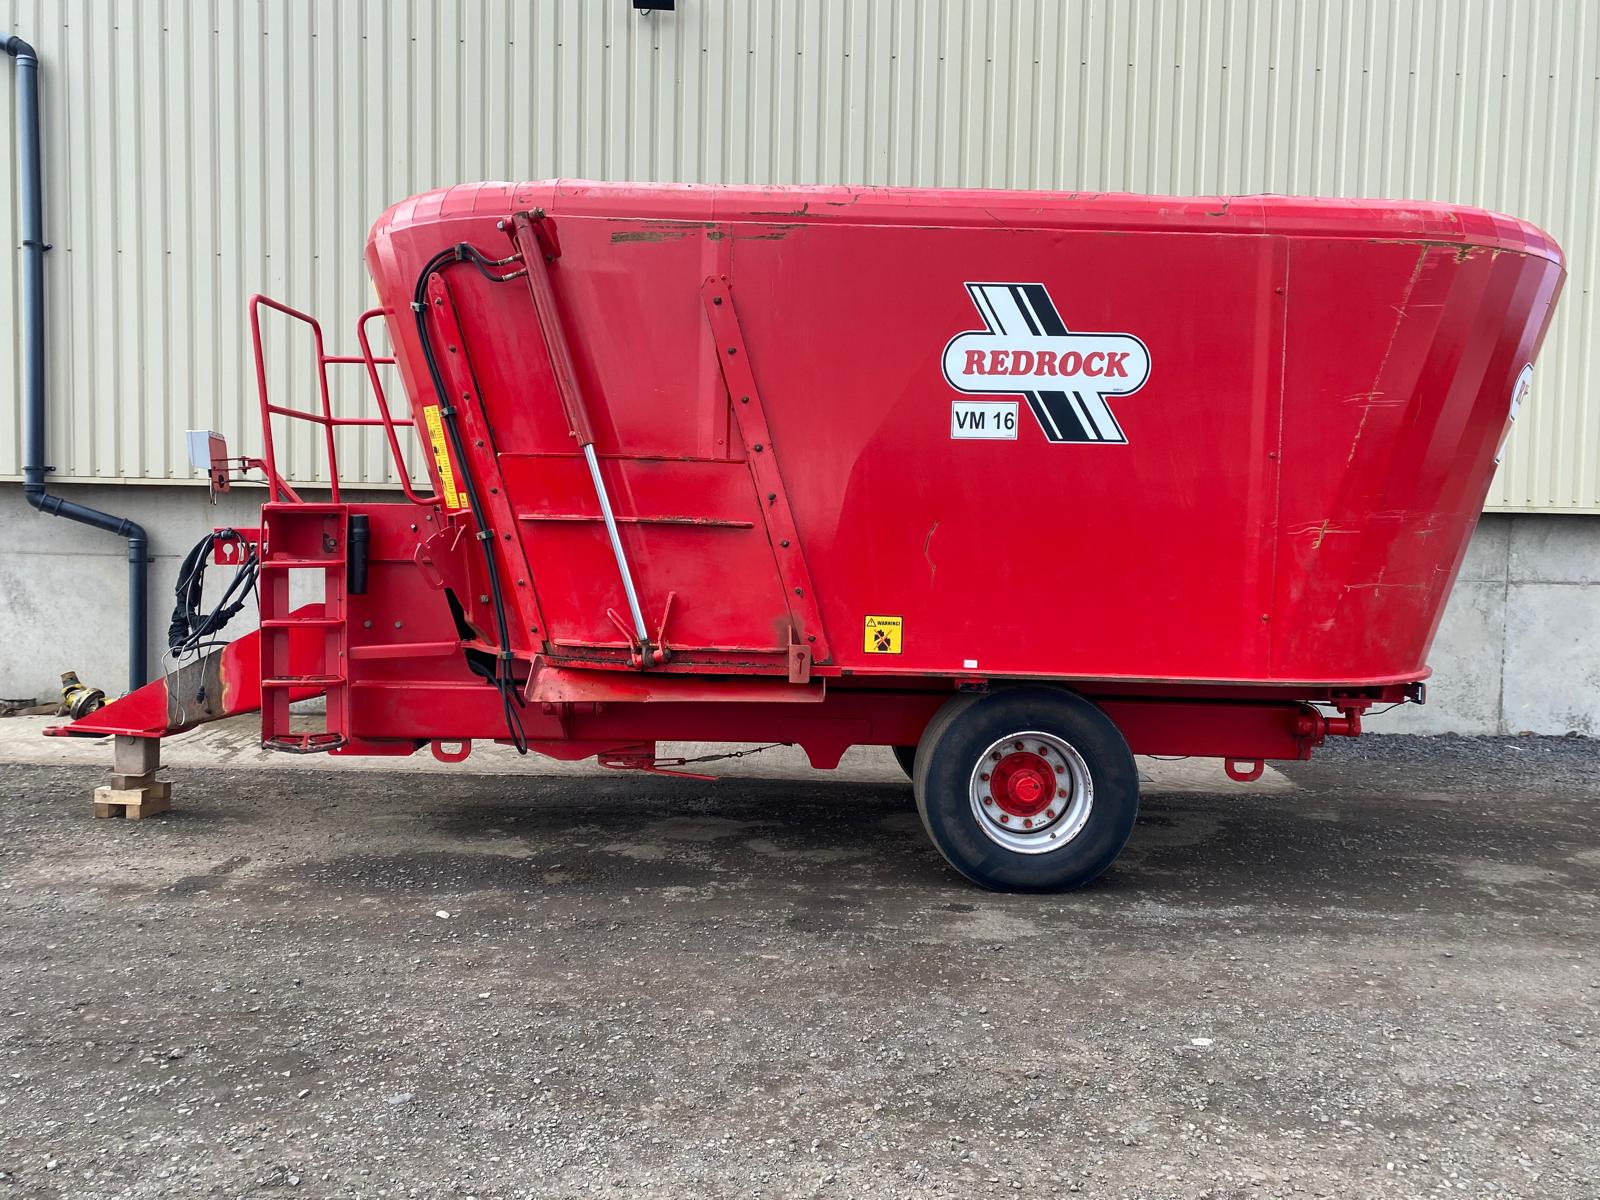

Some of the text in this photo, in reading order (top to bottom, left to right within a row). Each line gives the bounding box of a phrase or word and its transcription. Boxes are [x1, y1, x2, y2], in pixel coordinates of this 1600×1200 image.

[962, 350, 1131, 378] REDROCK
[955, 411, 1015, 430] VM 16
